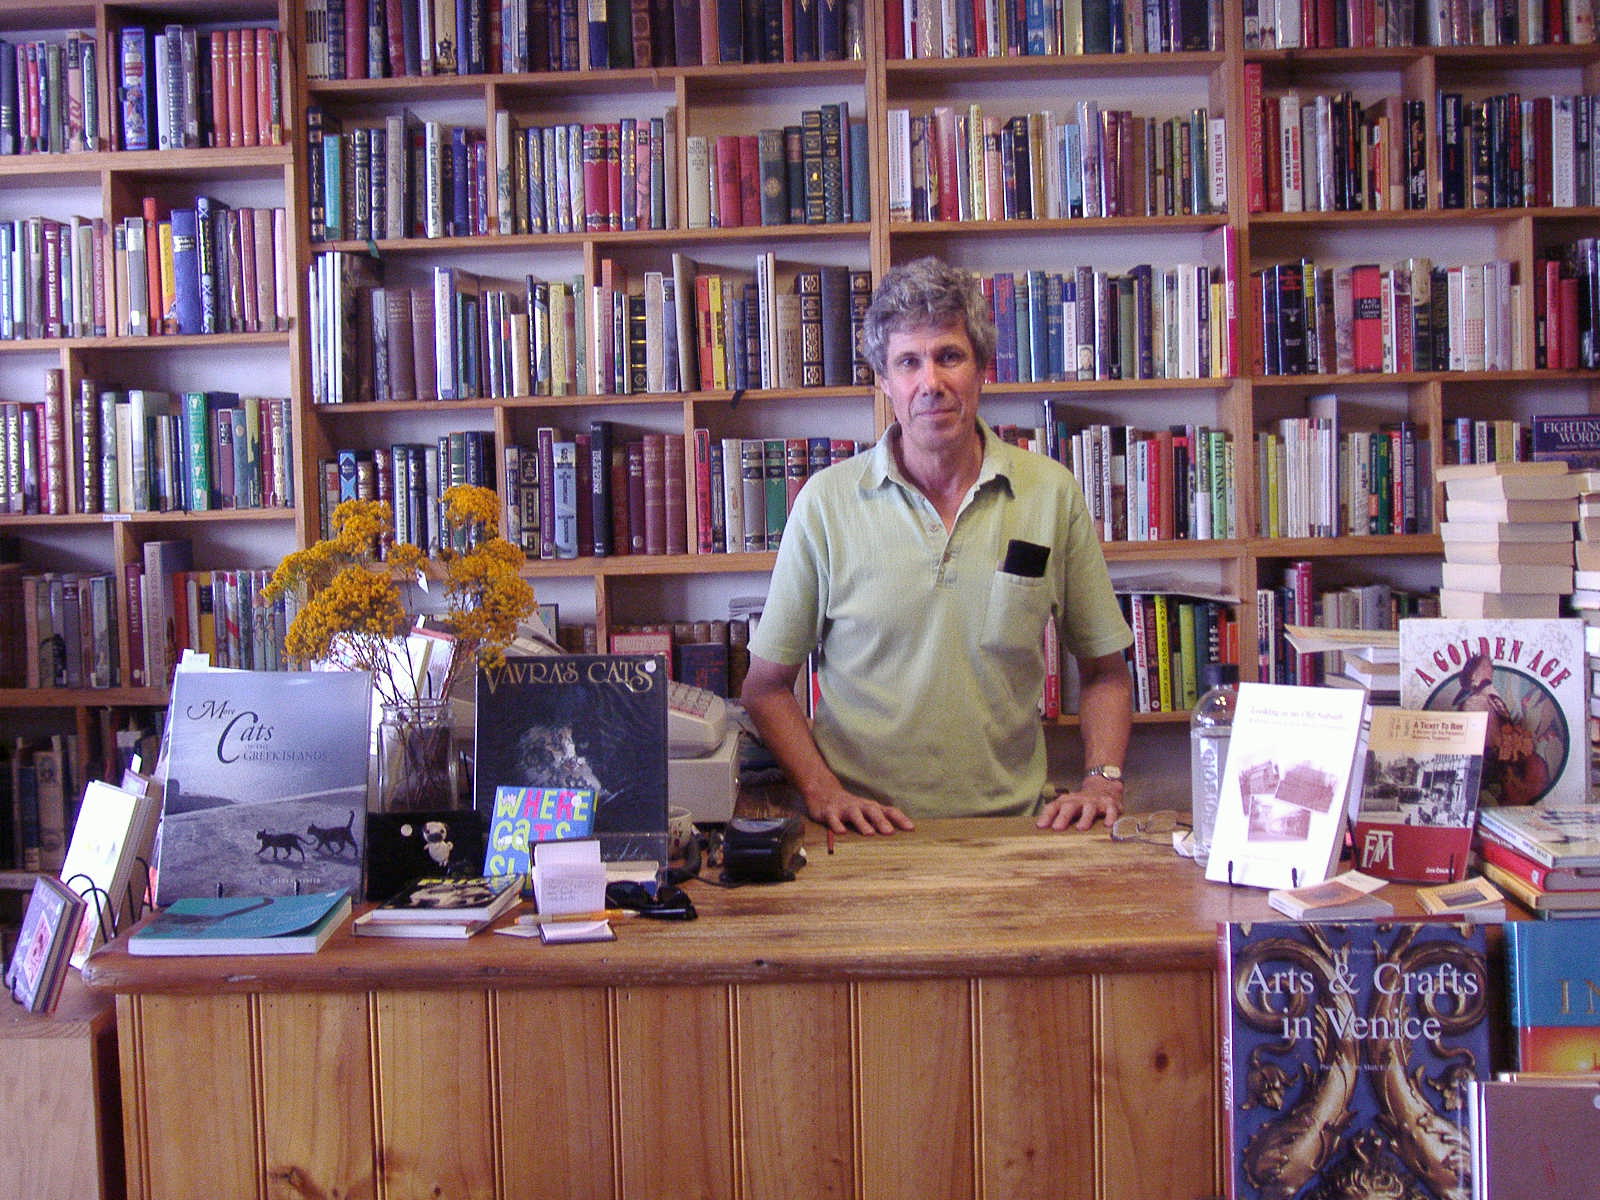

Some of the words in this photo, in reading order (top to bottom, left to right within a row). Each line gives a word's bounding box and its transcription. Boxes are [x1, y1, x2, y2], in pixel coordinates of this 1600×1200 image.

[1213, 133, 1223, 174] HUNTING
[1215, 177, 1224, 197] EVIL
[1214, 439, 1223, 459] THE
[1215, 462, 1224, 500] TANKS
[483, 661, 579, 695] VAVRA'S
[587, 658, 654, 693] CATS
[1415, 667, 1436, 688] A
[1432, 636, 1525, 673] GOLDEN
[1526, 649, 1573, 689] AGE
[217, 711, 276, 764] Cats
[243, 751, 281, 762] GREEK
[497, 788, 591, 821] WHERE
[1244, 963, 1315, 995] Arts
[1328, 963, 1360, 995] &
[1372, 962, 1479, 996] Crafts
[1281, 1007, 1315, 1040] in
[1324, 1007, 1443, 1041] Venice
